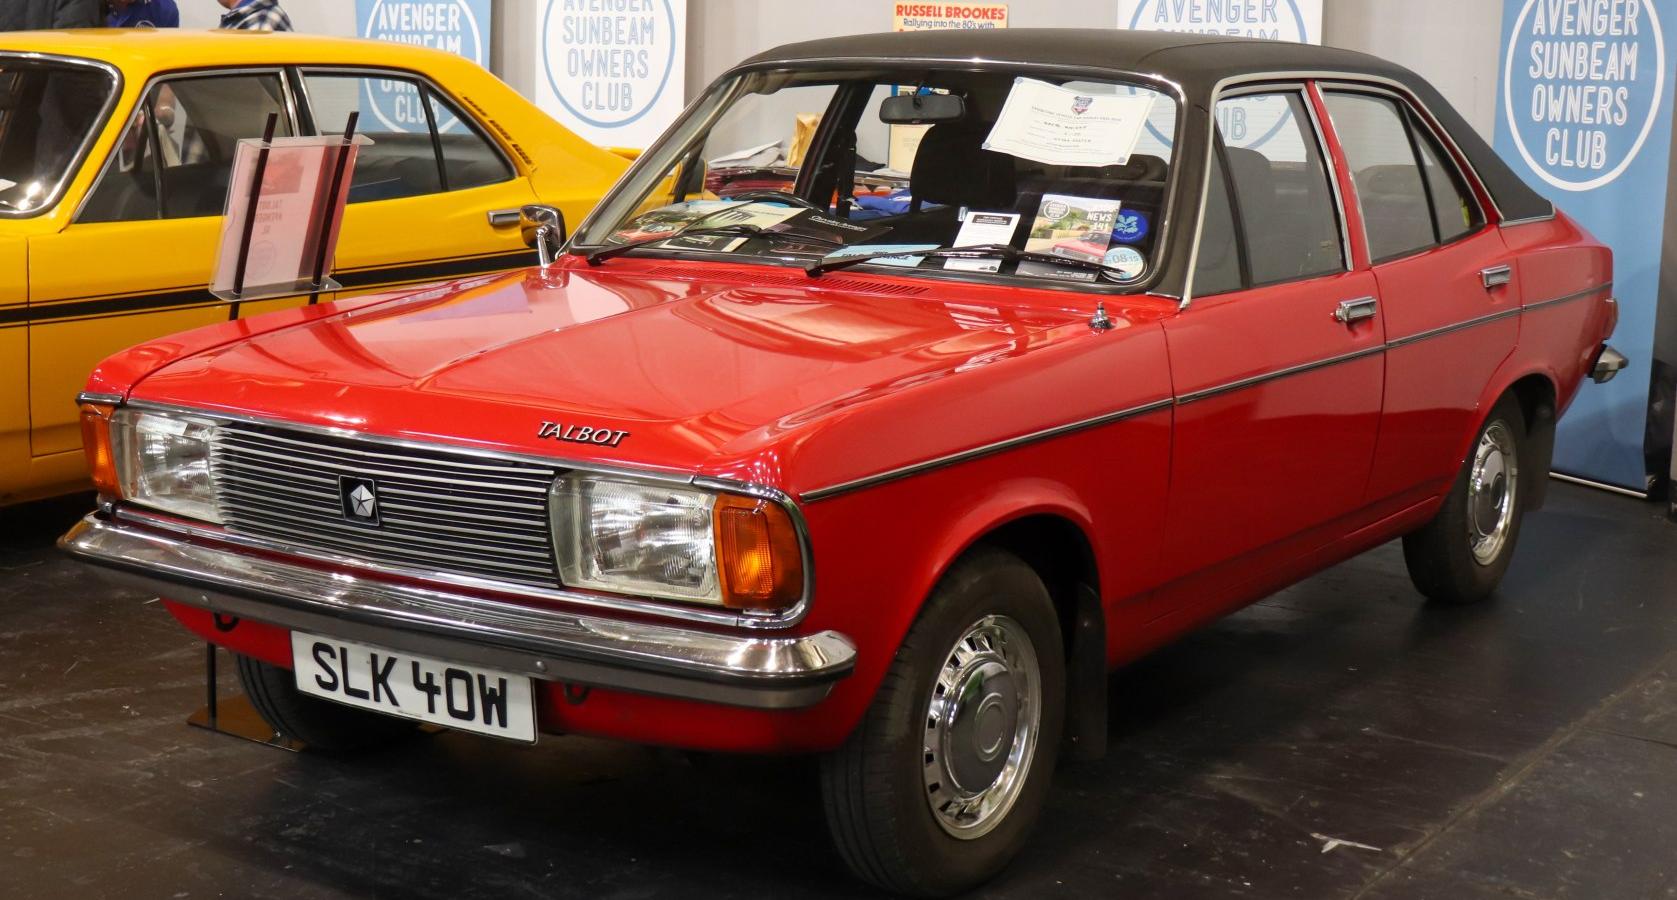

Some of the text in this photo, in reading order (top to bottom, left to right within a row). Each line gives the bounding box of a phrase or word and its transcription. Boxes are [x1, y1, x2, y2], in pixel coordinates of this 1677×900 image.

[378, 3, 461, 31] AVENGER
[896, 5, 1005, 20] RUSSELL BROOKES
[903, 18, 933, 29] Rallying
[934, 19, 947, 27] into
[948, 20, 961, 28] the
[977, 21, 995, 29] with
[1155, 0, 1278, 23] AVENGER
[1533, 0, 1639, 36] AVENGER
[562, 16, 655, 45] SUNBEAM
[567, 48, 649, 78] OWNERS
[1529, 41, 1639, 81] SUNBEAM
[582, 82, 633, 111] CLUB
[1531, 84, 1629, 126] OWNERS
[1545, 128, 1607, 170] CLUB
[1086, 211, 1112, 222] NEWS
[538, 421, 629, 446] TALBOT
[311, 641, 508, 728] SLK 40W
